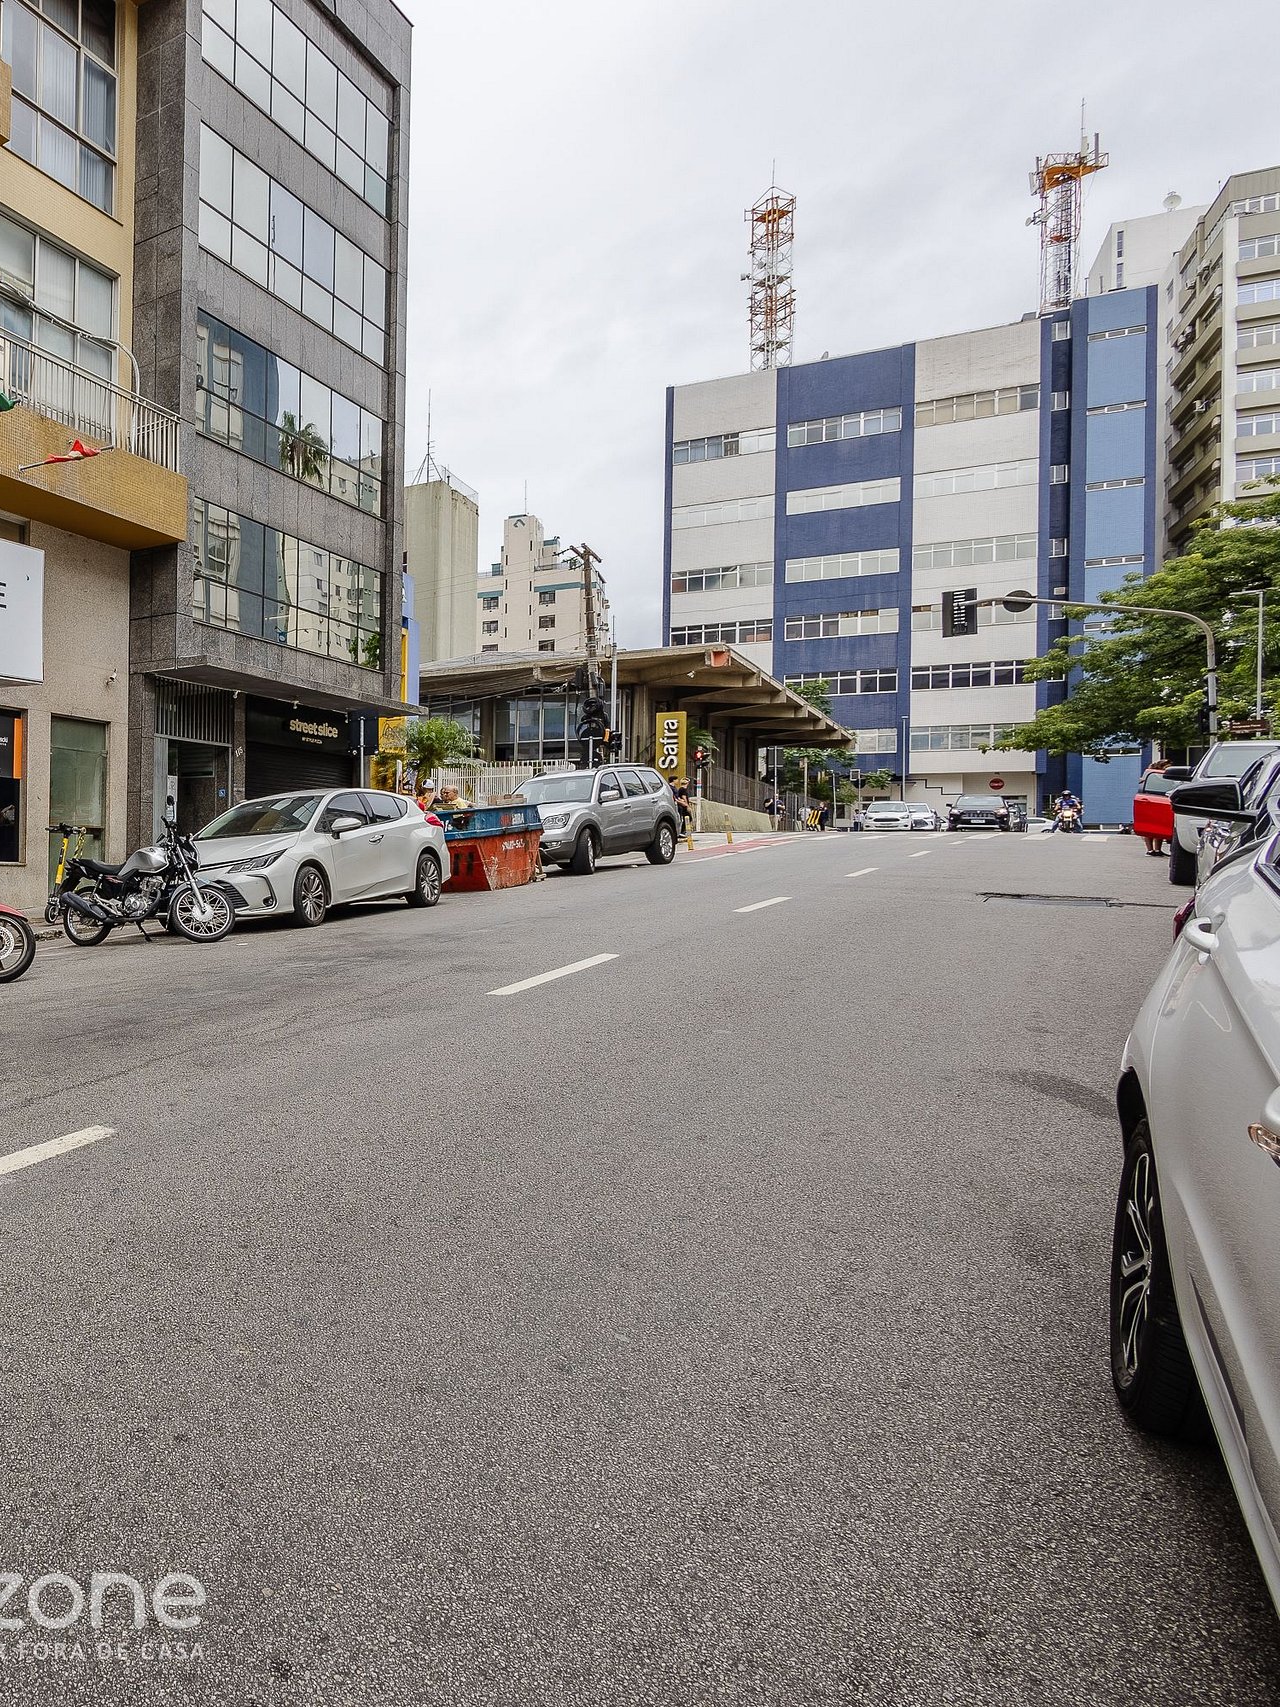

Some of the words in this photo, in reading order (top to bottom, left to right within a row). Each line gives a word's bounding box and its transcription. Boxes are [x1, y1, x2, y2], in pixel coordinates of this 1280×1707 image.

[290, 719, 317, 735] street
[318, 722, 338, 738] slice
[658, 719, 678, 769] Safra
